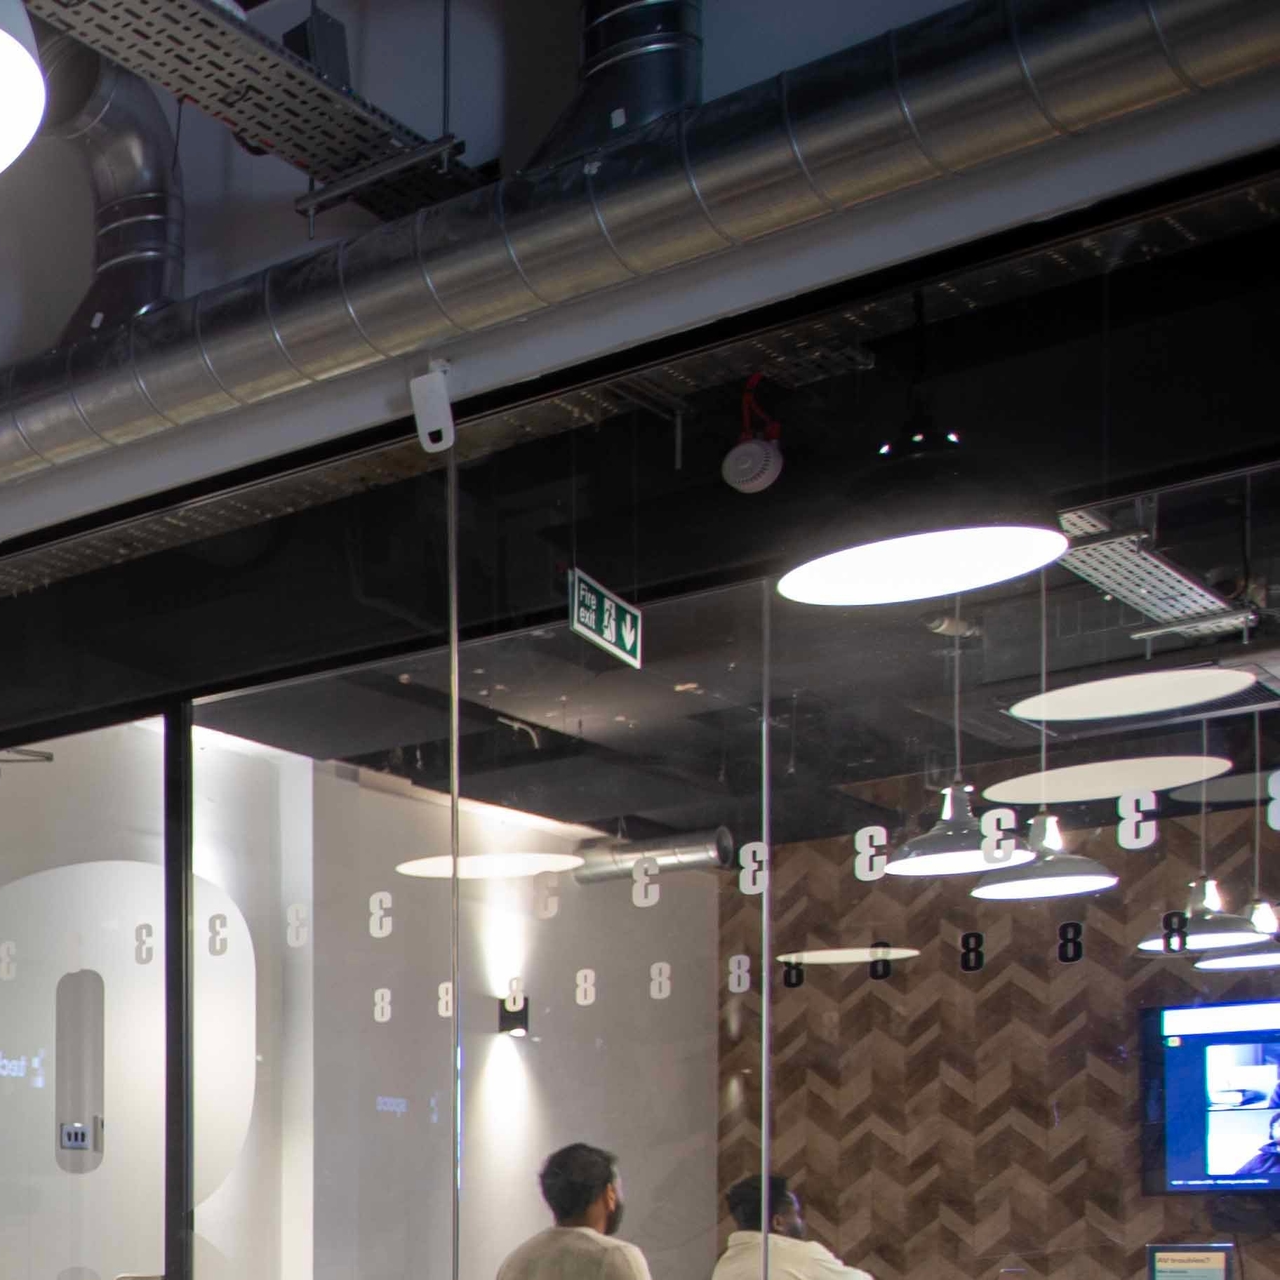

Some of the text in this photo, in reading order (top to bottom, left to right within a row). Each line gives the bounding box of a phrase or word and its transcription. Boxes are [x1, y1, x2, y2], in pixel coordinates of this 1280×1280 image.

[580, 582, 597, 609] Fire
[580, 607, 595, 629] exit
[374, 988, 391, 1022] 8
[504, 977, 525, 1012] 8
[576, 969, 595, 1006] 8
[650, 962, 671, 999] 8
[729, 955, 750, 993] 8
[961, 932, 984, 971] 8
[1058, 922, 1083, 963] 8
[1163, 911, 1188, 953] 8
